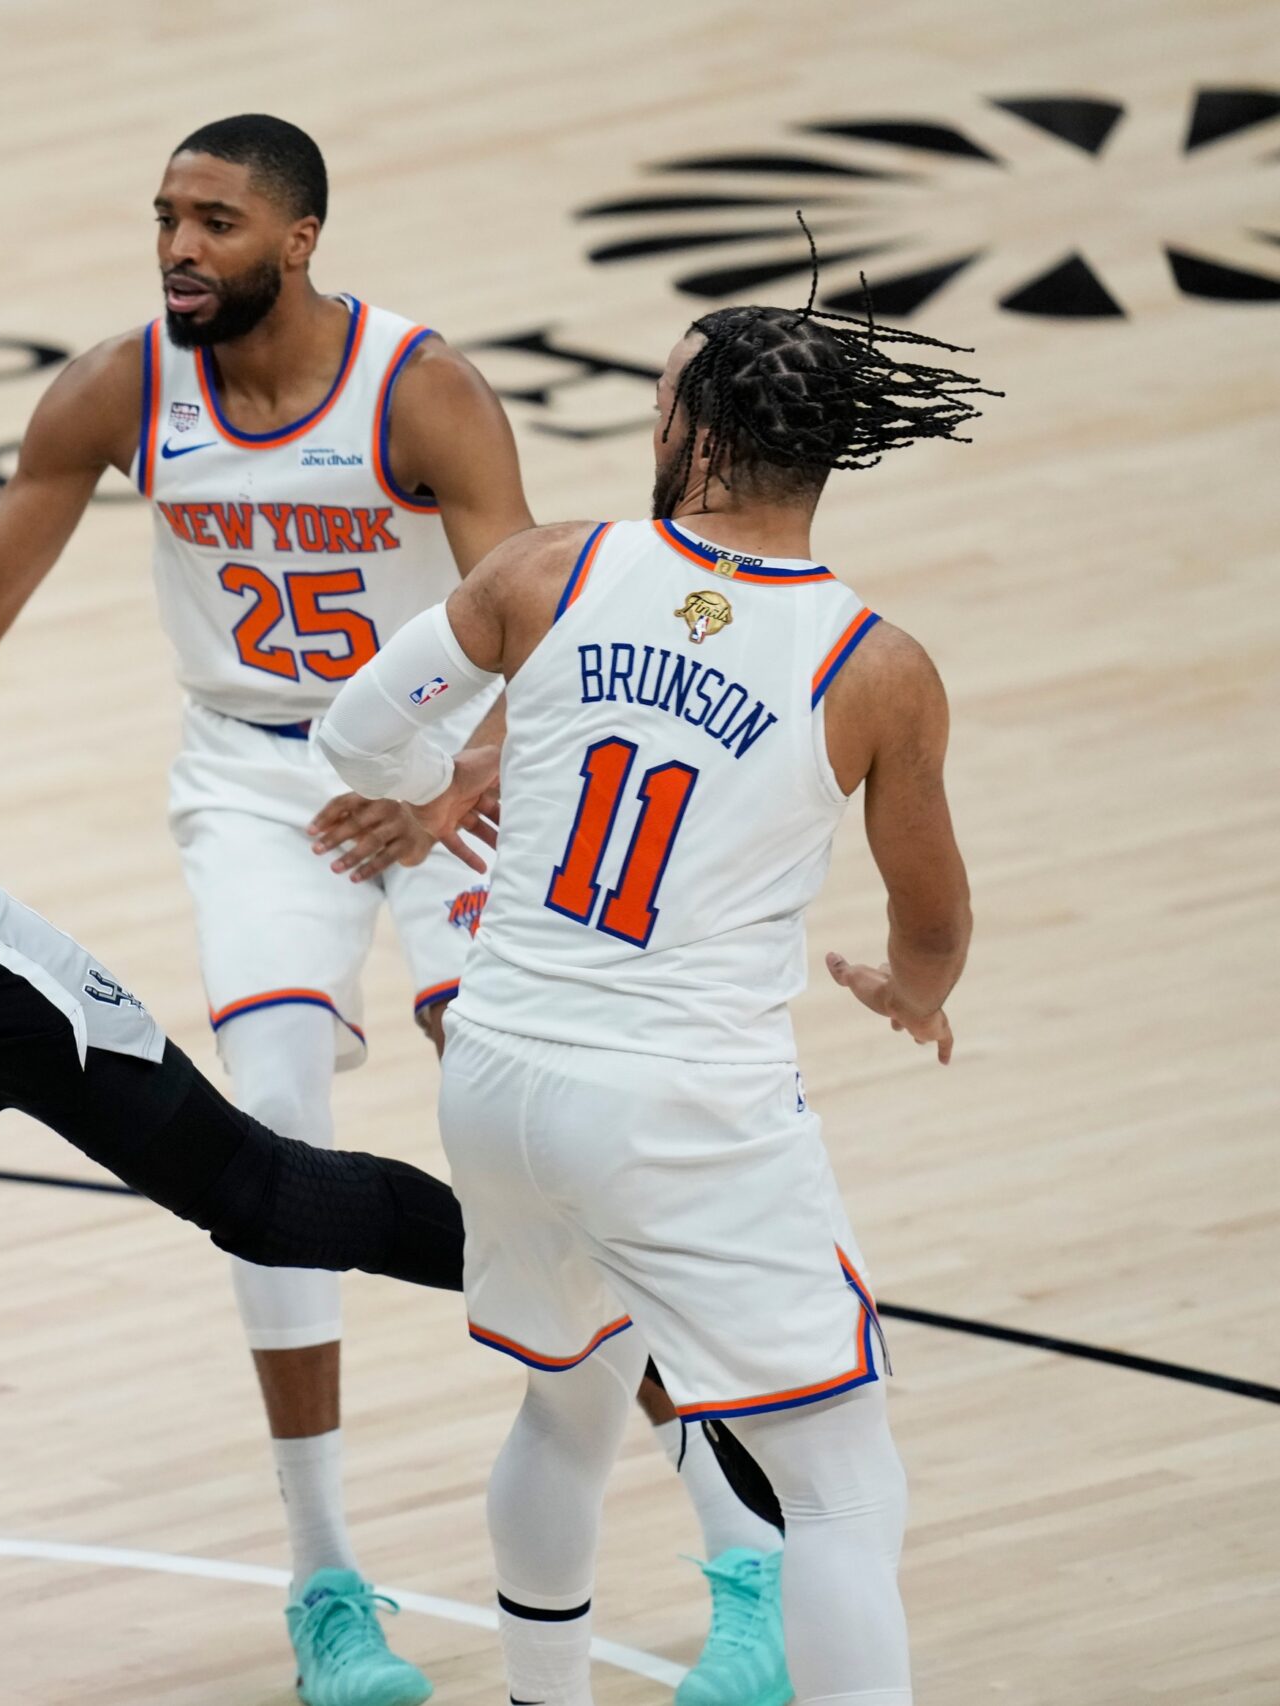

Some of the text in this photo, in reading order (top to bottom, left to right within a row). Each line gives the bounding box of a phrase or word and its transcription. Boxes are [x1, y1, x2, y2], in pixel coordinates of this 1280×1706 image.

[301, 453, 363, 466] abu dhabi
[157, 501, 401, 553] NEW YORK
[732, 555, 764, 567] PRO
[218, 562, 380, 683] 25
[682, 594, 730, 624] Finals
[577, 642, 779, 760] BRUNSON
[544, 735, 700, 950] 11
